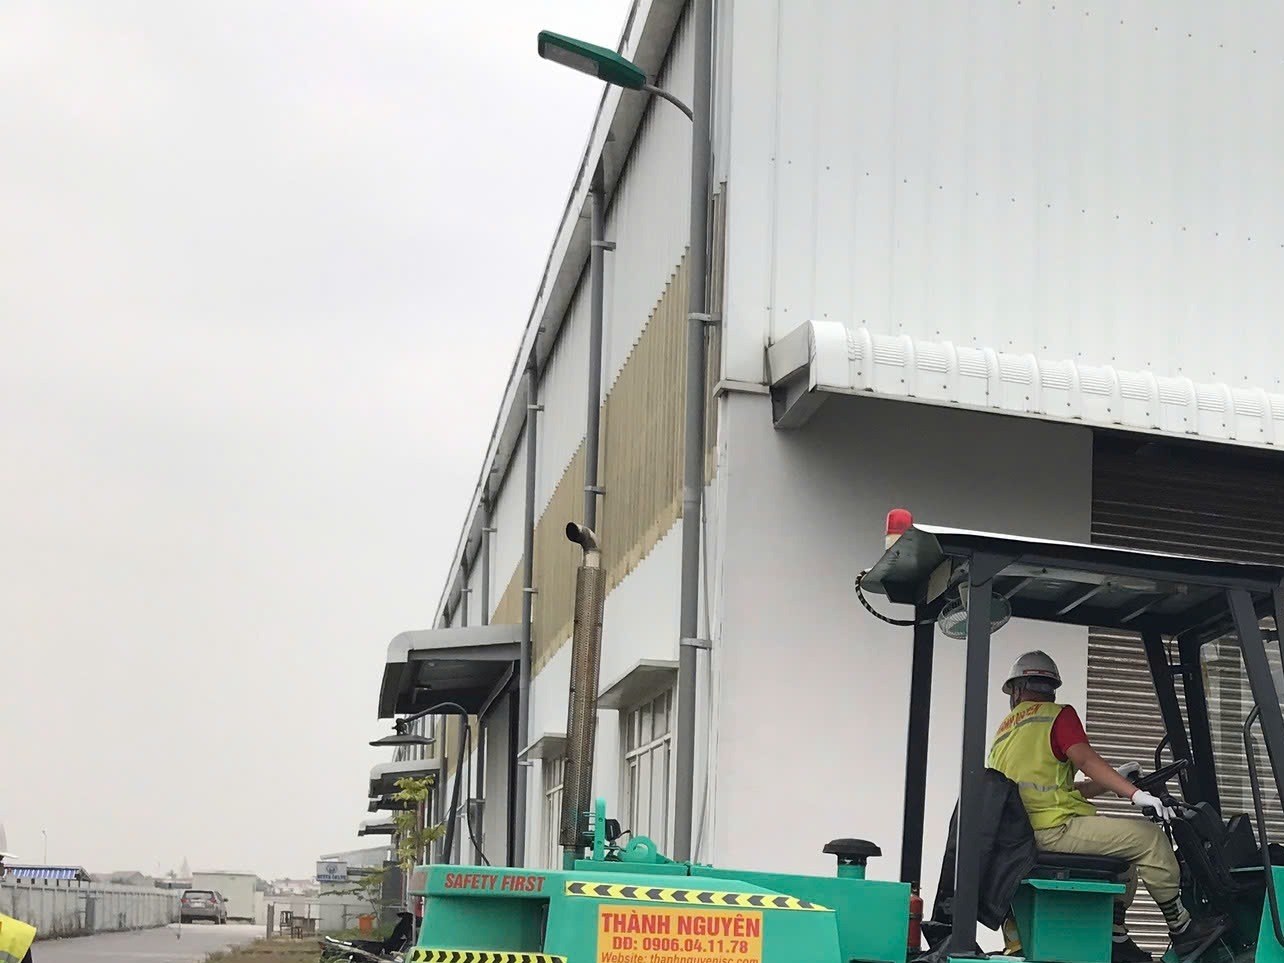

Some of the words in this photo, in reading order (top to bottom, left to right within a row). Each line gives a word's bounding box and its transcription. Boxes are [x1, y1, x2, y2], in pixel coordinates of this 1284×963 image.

[444, 873, 498, 890] SAFETY
[501, 875, 545, 892] FIRST
[601, 910, 671, 935] THÀNH
[677, 913, 760, 938] NGUYÊN
[642, 937, 749, 954] 0906.04.11.78
